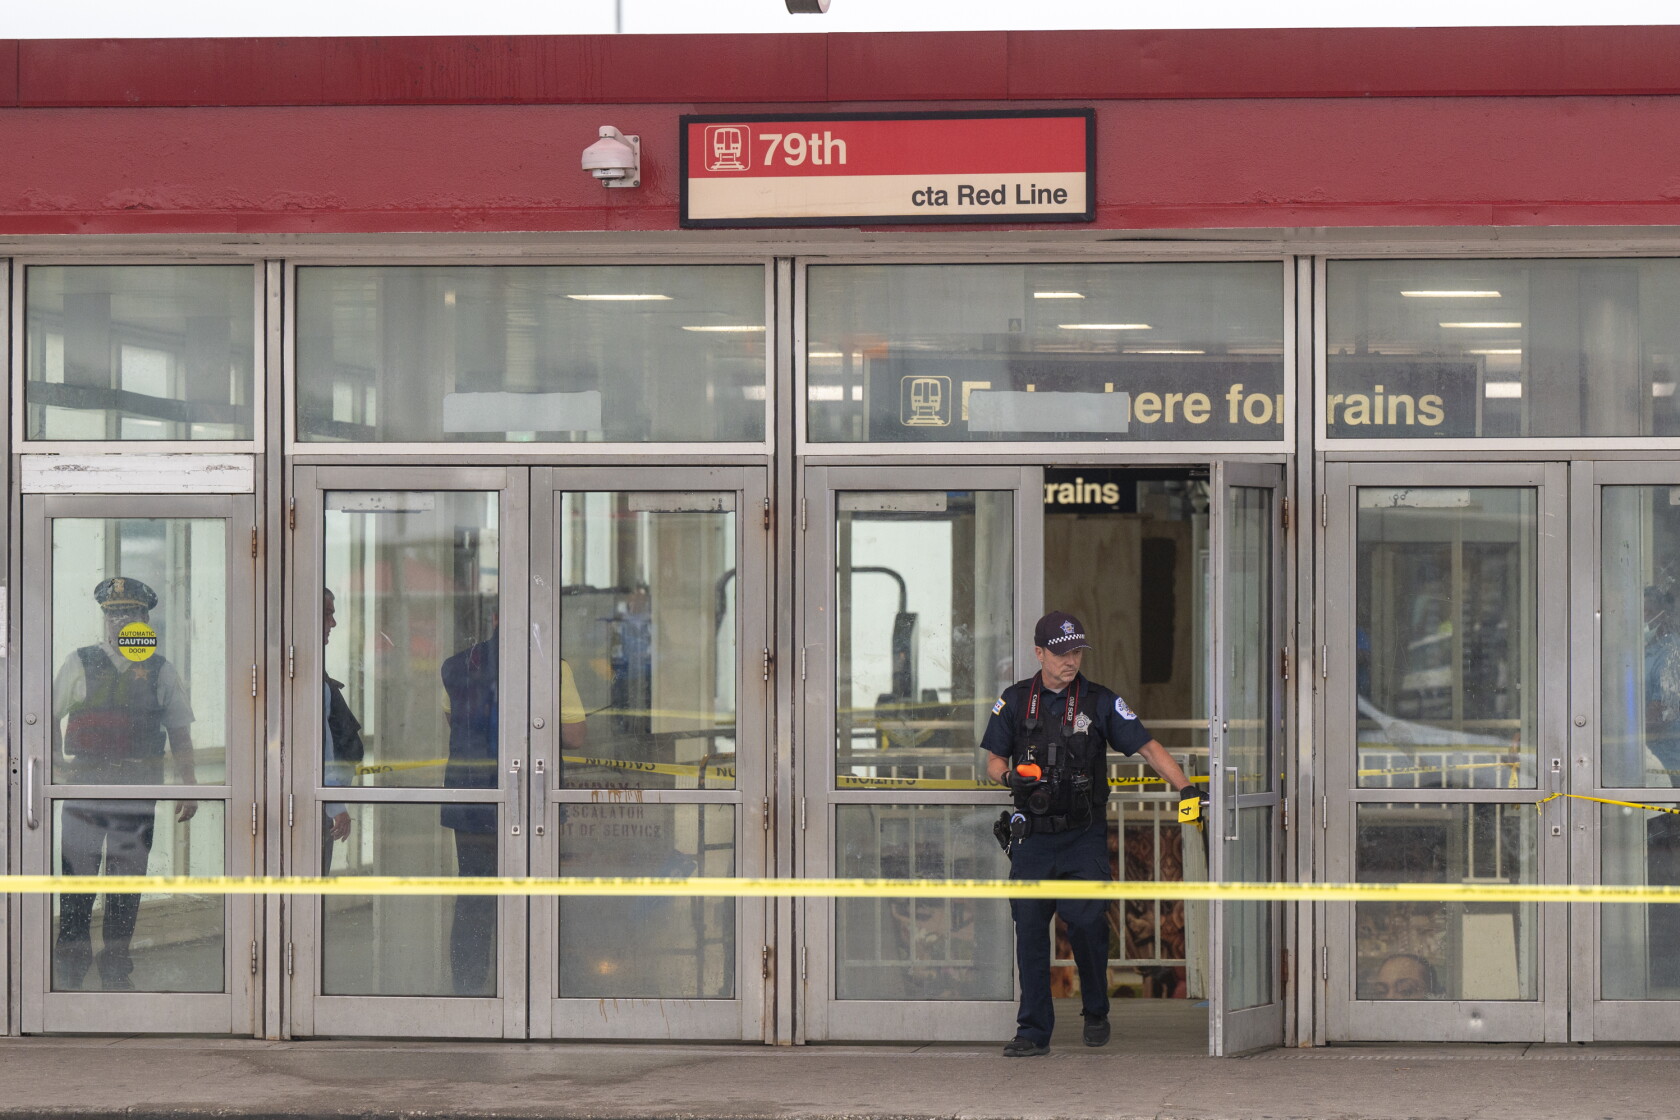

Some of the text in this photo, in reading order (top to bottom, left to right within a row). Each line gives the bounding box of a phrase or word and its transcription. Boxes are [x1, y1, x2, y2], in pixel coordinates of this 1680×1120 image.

[760, 131, 846, 166] 79th
[911, 183, 1068, 206] cta Red Line
[1327, 384, 1445, 426] rains
[1044, 477, 1120, 504] rains
[1180, 806, 1192, 815] 4
